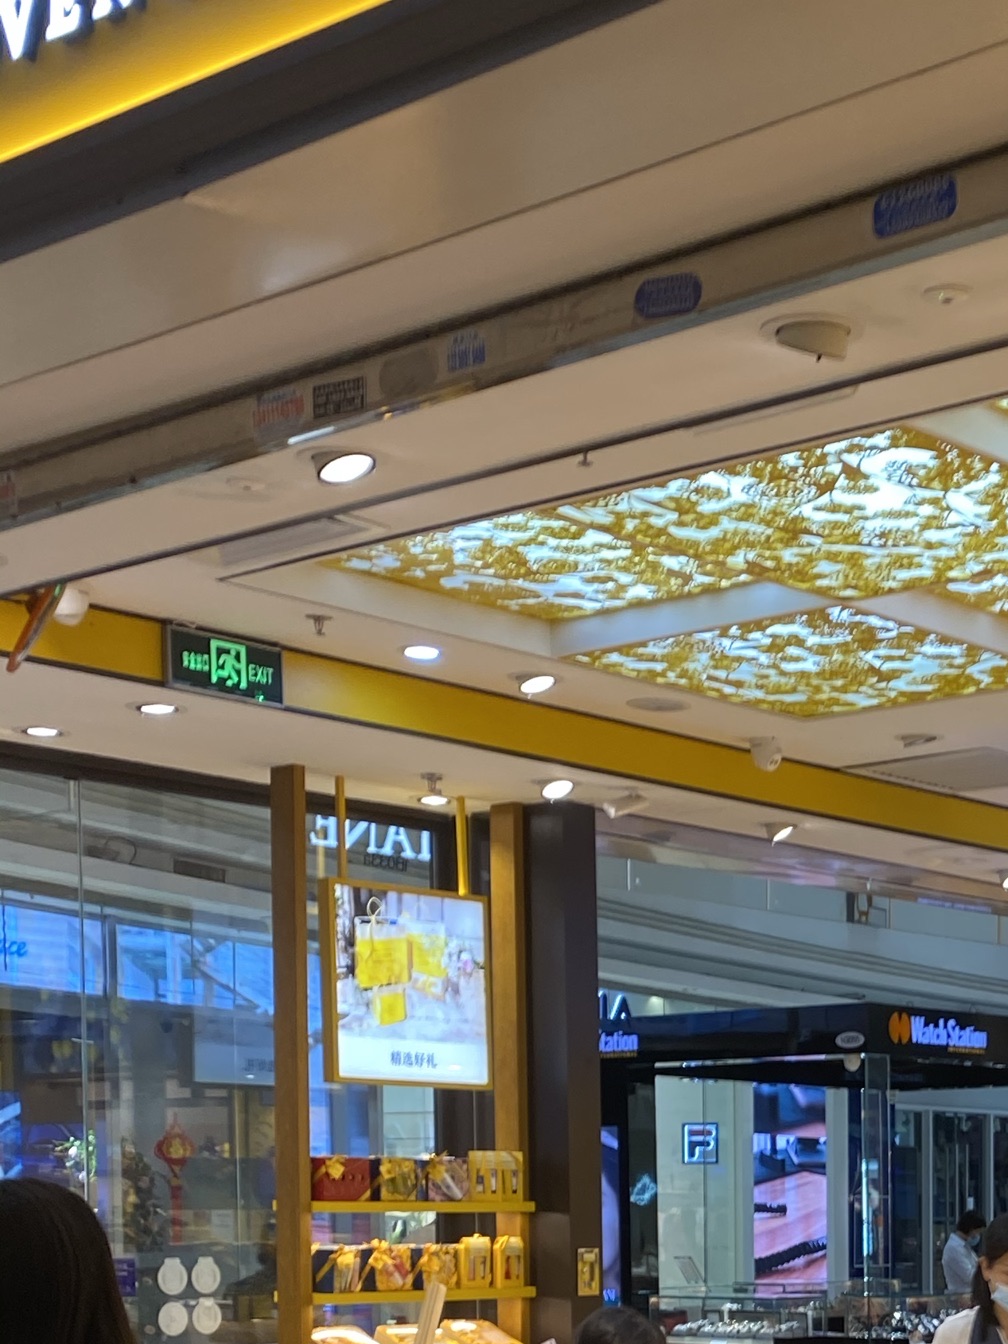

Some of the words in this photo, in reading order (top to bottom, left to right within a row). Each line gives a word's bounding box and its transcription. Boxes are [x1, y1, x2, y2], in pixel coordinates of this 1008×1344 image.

[248, 663, 274, 685] EXIT
[910, 1015, 947, 1046] Watch
[947, 1018, 988, 1049] Station
[390, 1050, 438, 1068] 精选好礼
